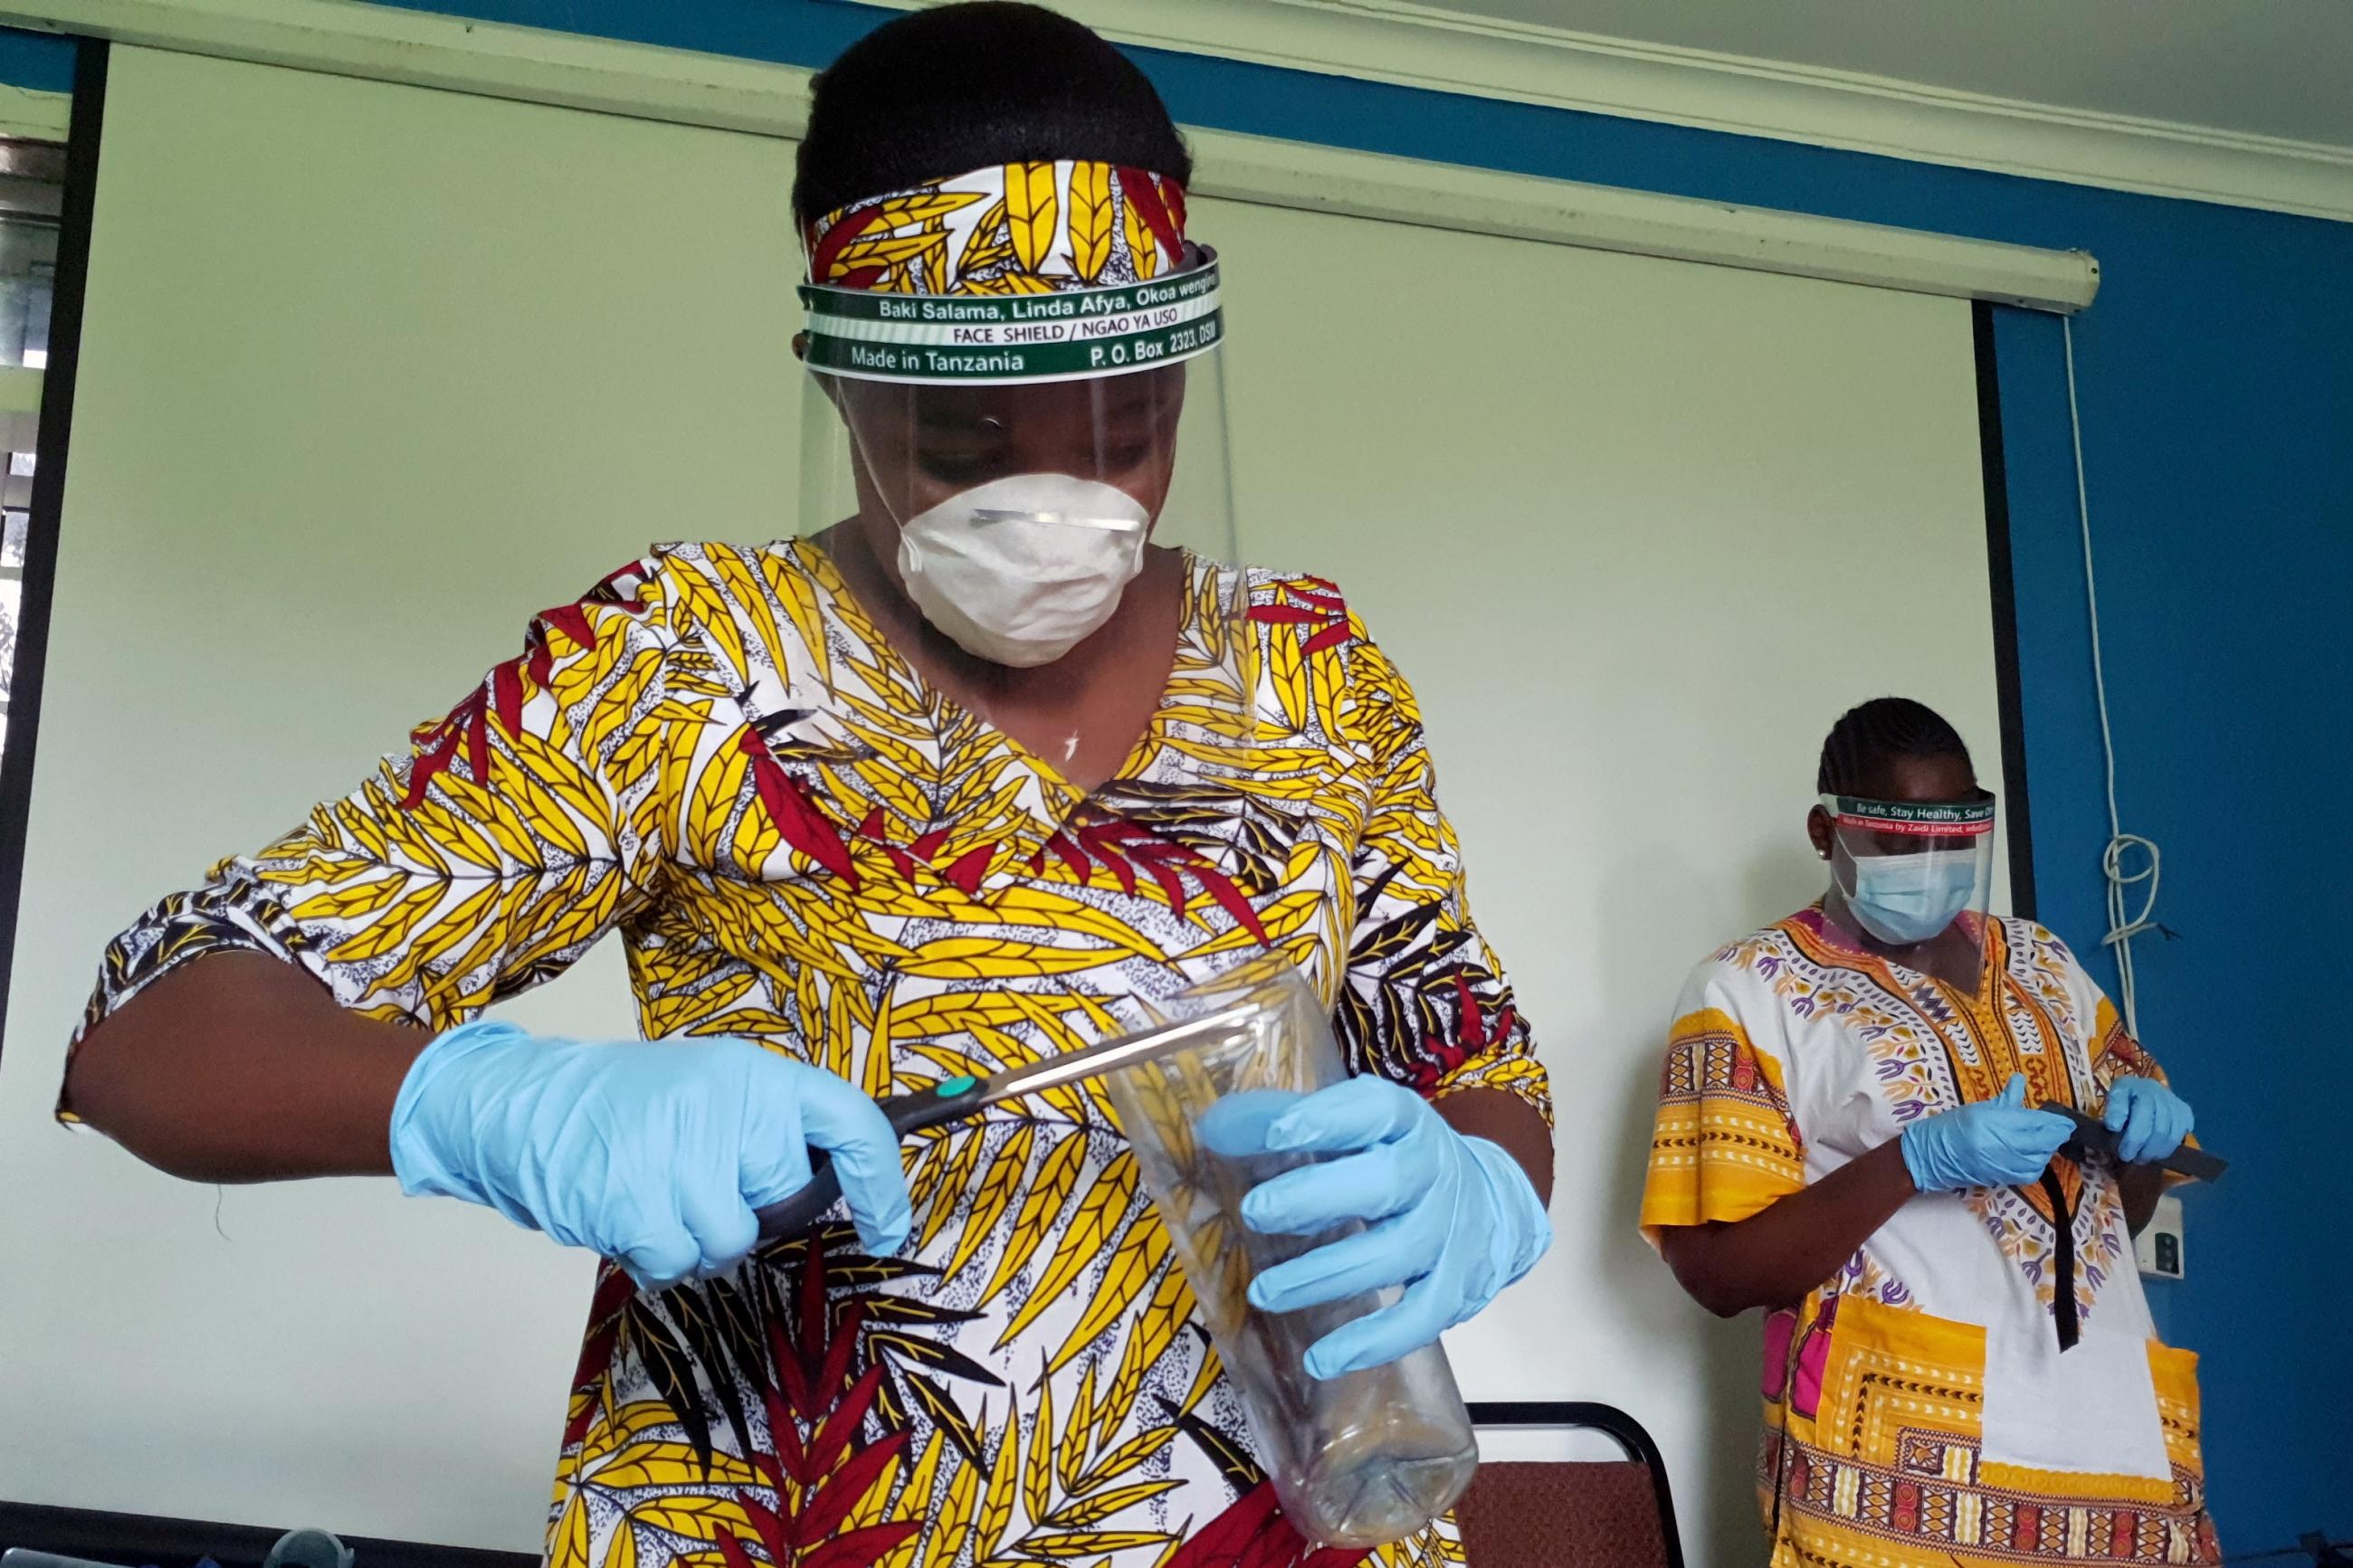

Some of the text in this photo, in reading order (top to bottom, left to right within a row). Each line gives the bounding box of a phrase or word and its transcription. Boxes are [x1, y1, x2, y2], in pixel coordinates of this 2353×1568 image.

[880, 301, 916, 318] Baki
[922, 302, 1005, 321] Salama,
[1013, 299, 1074, 319] Linda
[1080, 295, 1131, 316] Afya,
[1137, 287, 1176, 306] Okoa
[954, 308, 1177, 343] FACE SHIELD / NGAO YA USO
[852, 347, 1024, 371] Made in Tanzania
[1091, 347, 1106, 366] P.
[1111, 344, 1130, 364] O.
[1135, 340, 1164, 361] Box
[1170, 330, 1197, 354] 2323,
[1891, 806, 1914, 820] Stay
[1917, 808, 1962, 822] Healthy,
[1965, 809, 1985, 820] Save
[1895, 823, 1906, 832] by
